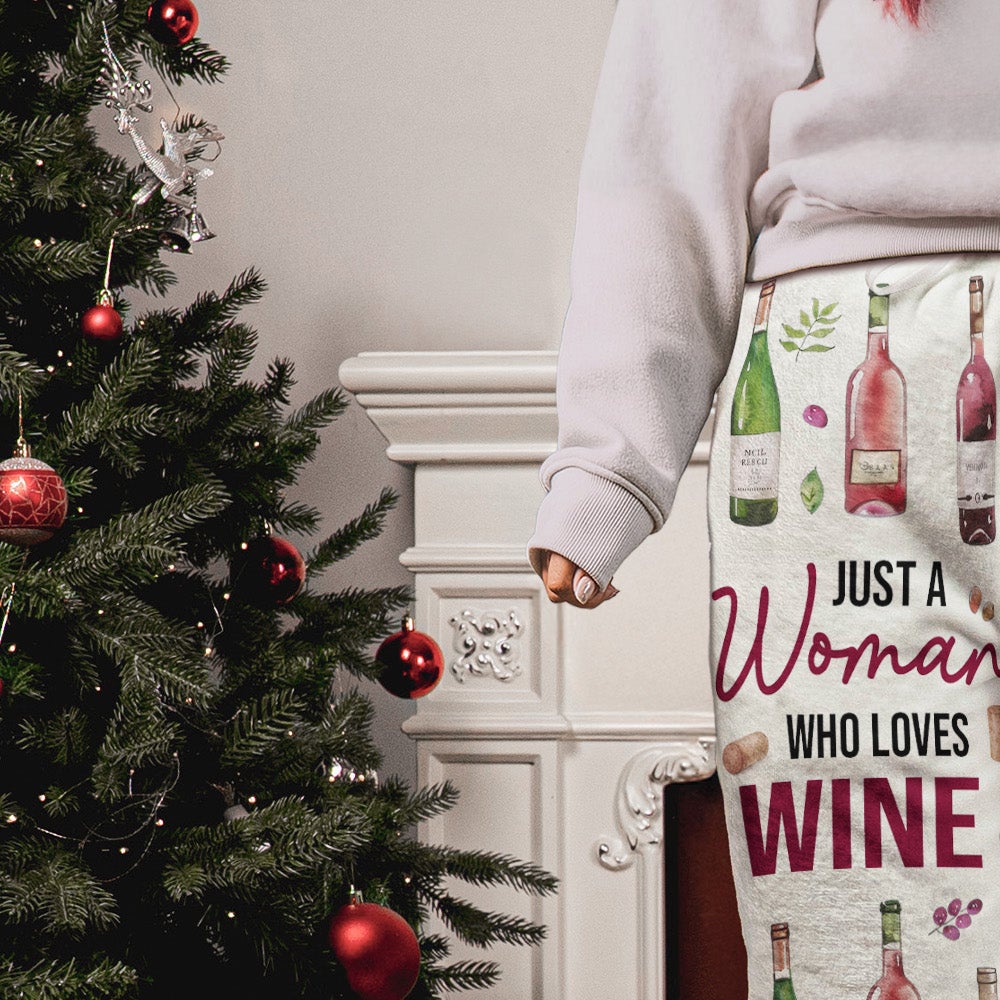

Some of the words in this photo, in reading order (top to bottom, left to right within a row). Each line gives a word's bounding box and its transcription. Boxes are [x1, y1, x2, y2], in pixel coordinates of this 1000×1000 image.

[832, 560, 912, 607] JUST
[926, 560, 947, 607] A
[786, 712, 860, 760] WHO
[871, 712, 970, 758] LOVES
[739, 777, 983, 876] WINE
